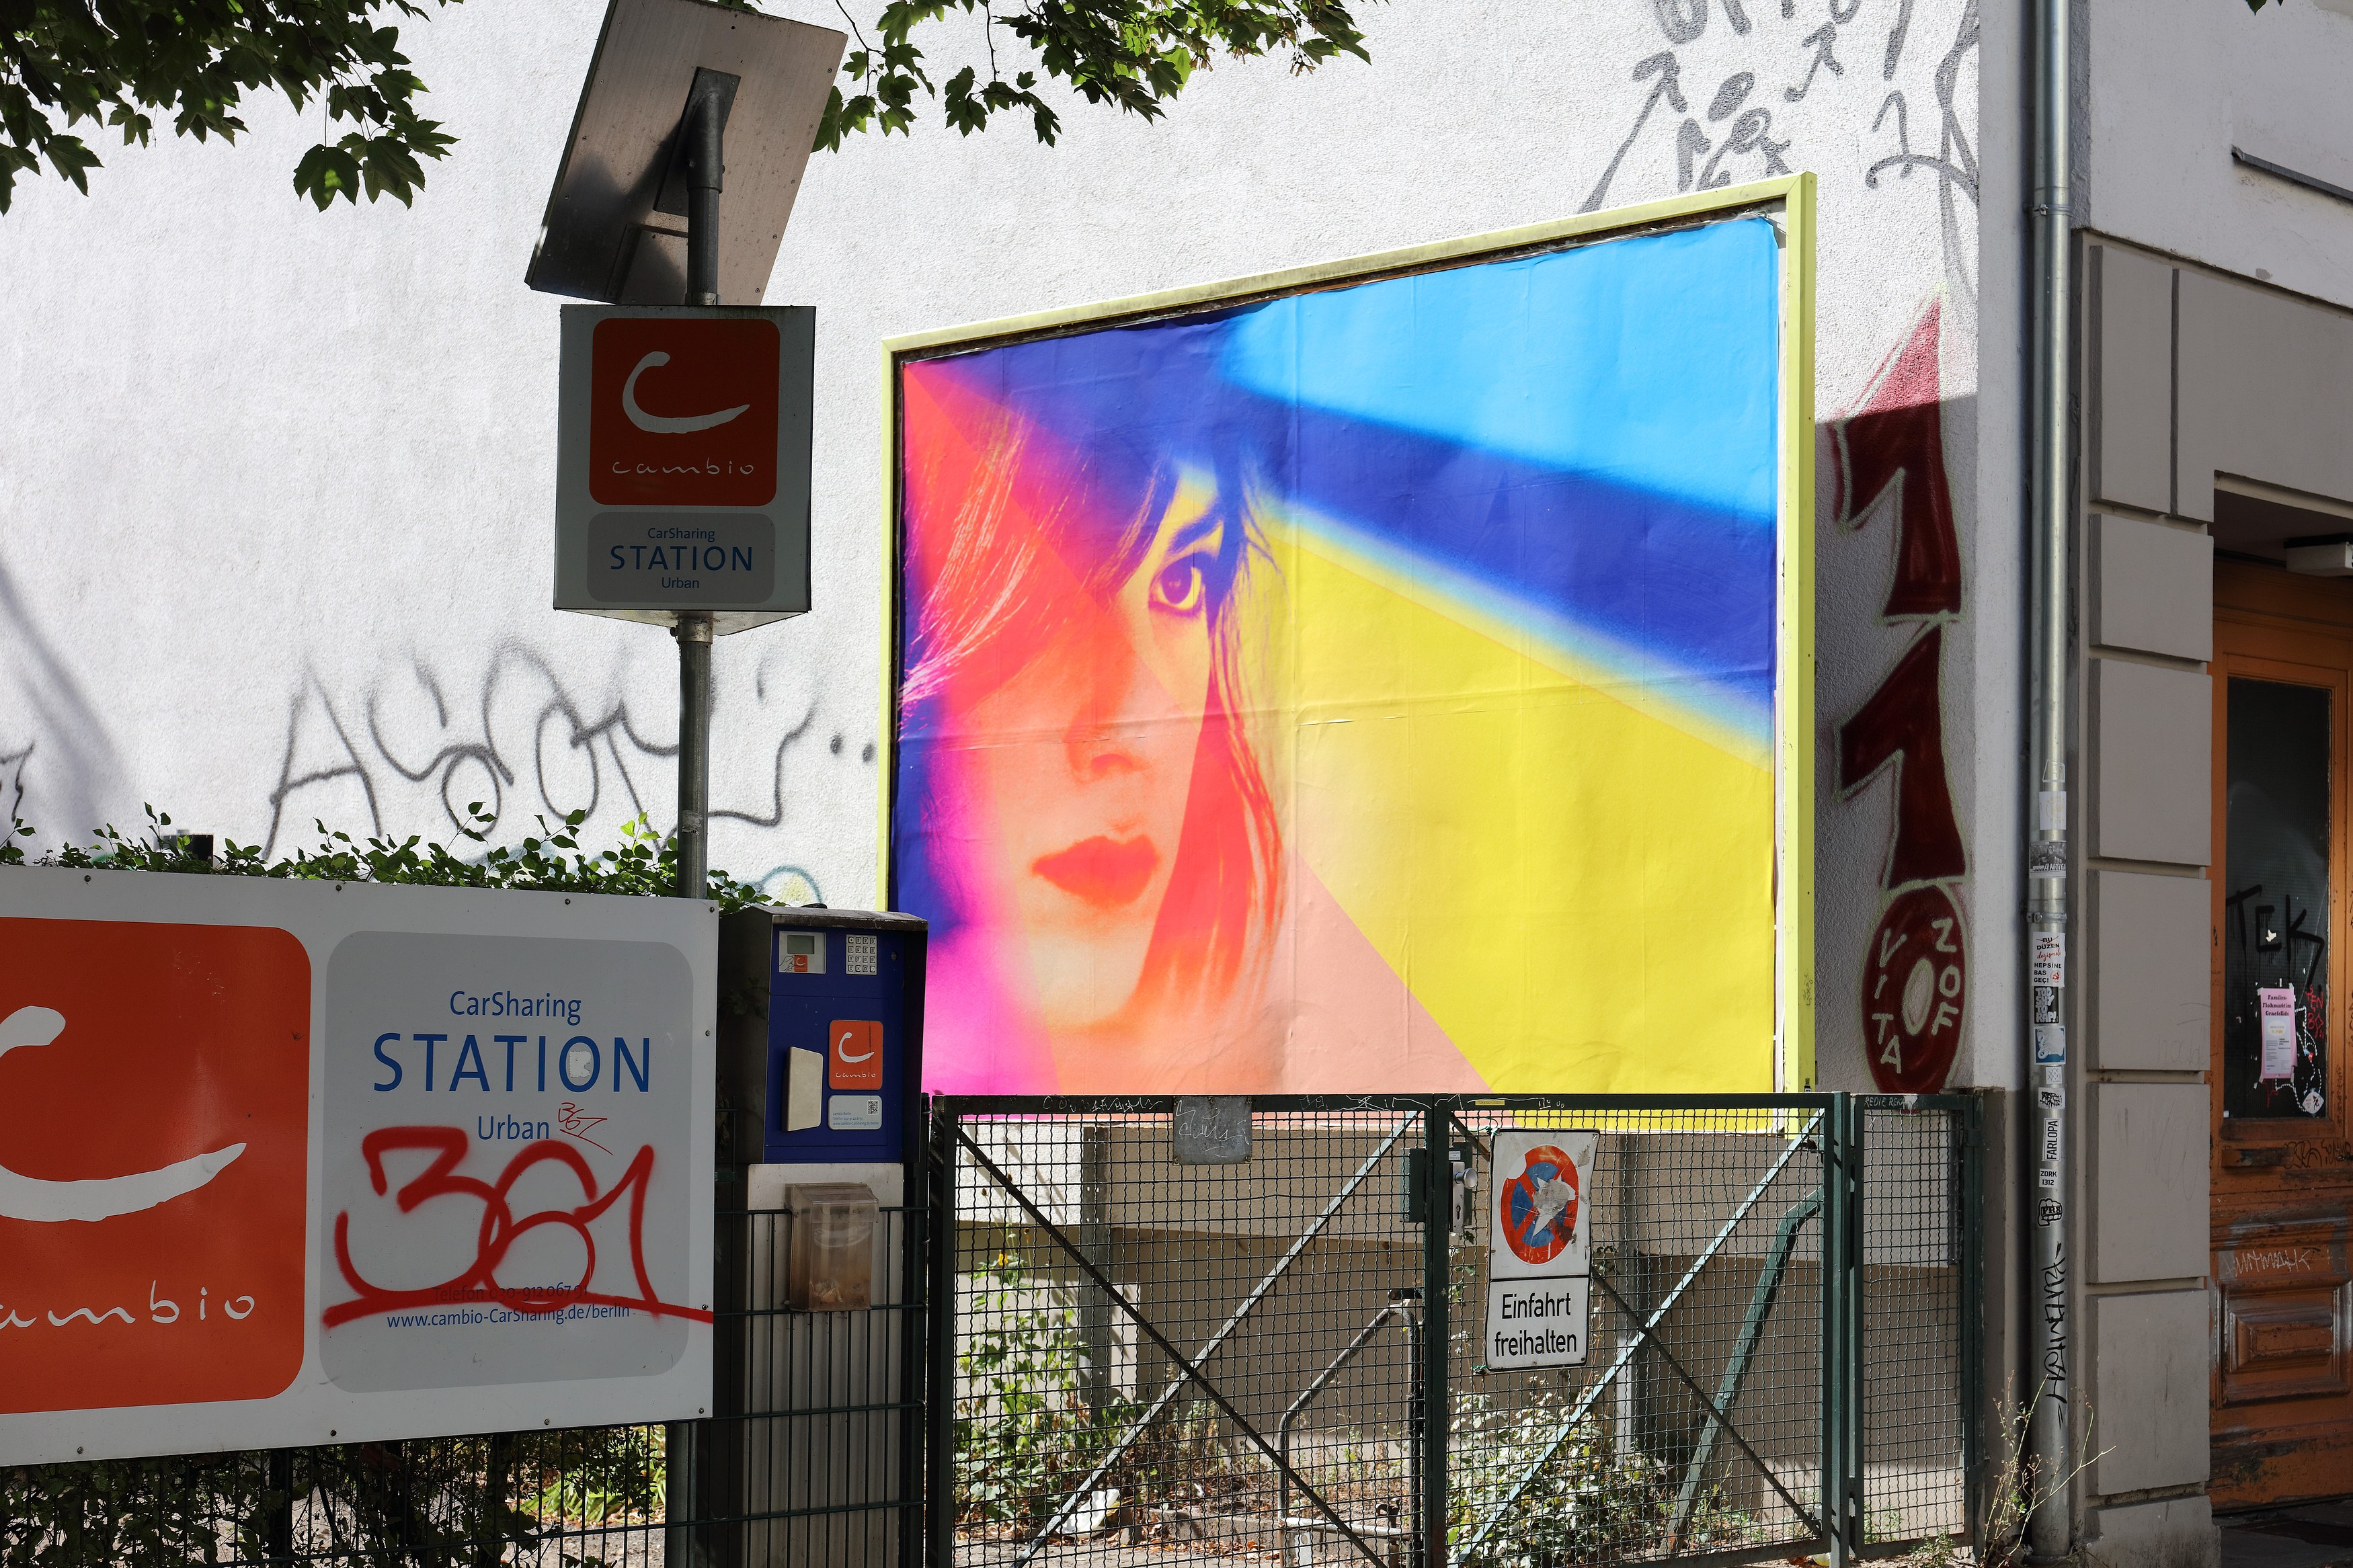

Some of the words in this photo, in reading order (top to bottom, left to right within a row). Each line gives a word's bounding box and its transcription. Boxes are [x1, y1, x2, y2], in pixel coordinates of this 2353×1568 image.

[612, 457, 754, 474] cambio
[647, 528, 715, 542] CarSharing
[610, 545, 752, 571] STATION
[662, 577, 700, 589] Urban
[449, 990, 581, 1026] CarSharing
[2035, 1005, 2048, 1013] TO
[2036, 995, 2055, 1005] SHY
[2036, 1011, 2057, 1023] RAP!
[373, 1032, 649, 1092] STATION
[477, 1114, 550, 1140] Urban
[2046, 1120, 2059, 1159] FARLOPA
[433, 1286, 483, 1302] Telefon
[1501, 1292, 1571, 1319] Einfahrt
[387, 1303, 630, 1328] www.cambio-CarSharing.de/berlin
[1494, 1328, 1577, 1357] freihalten
